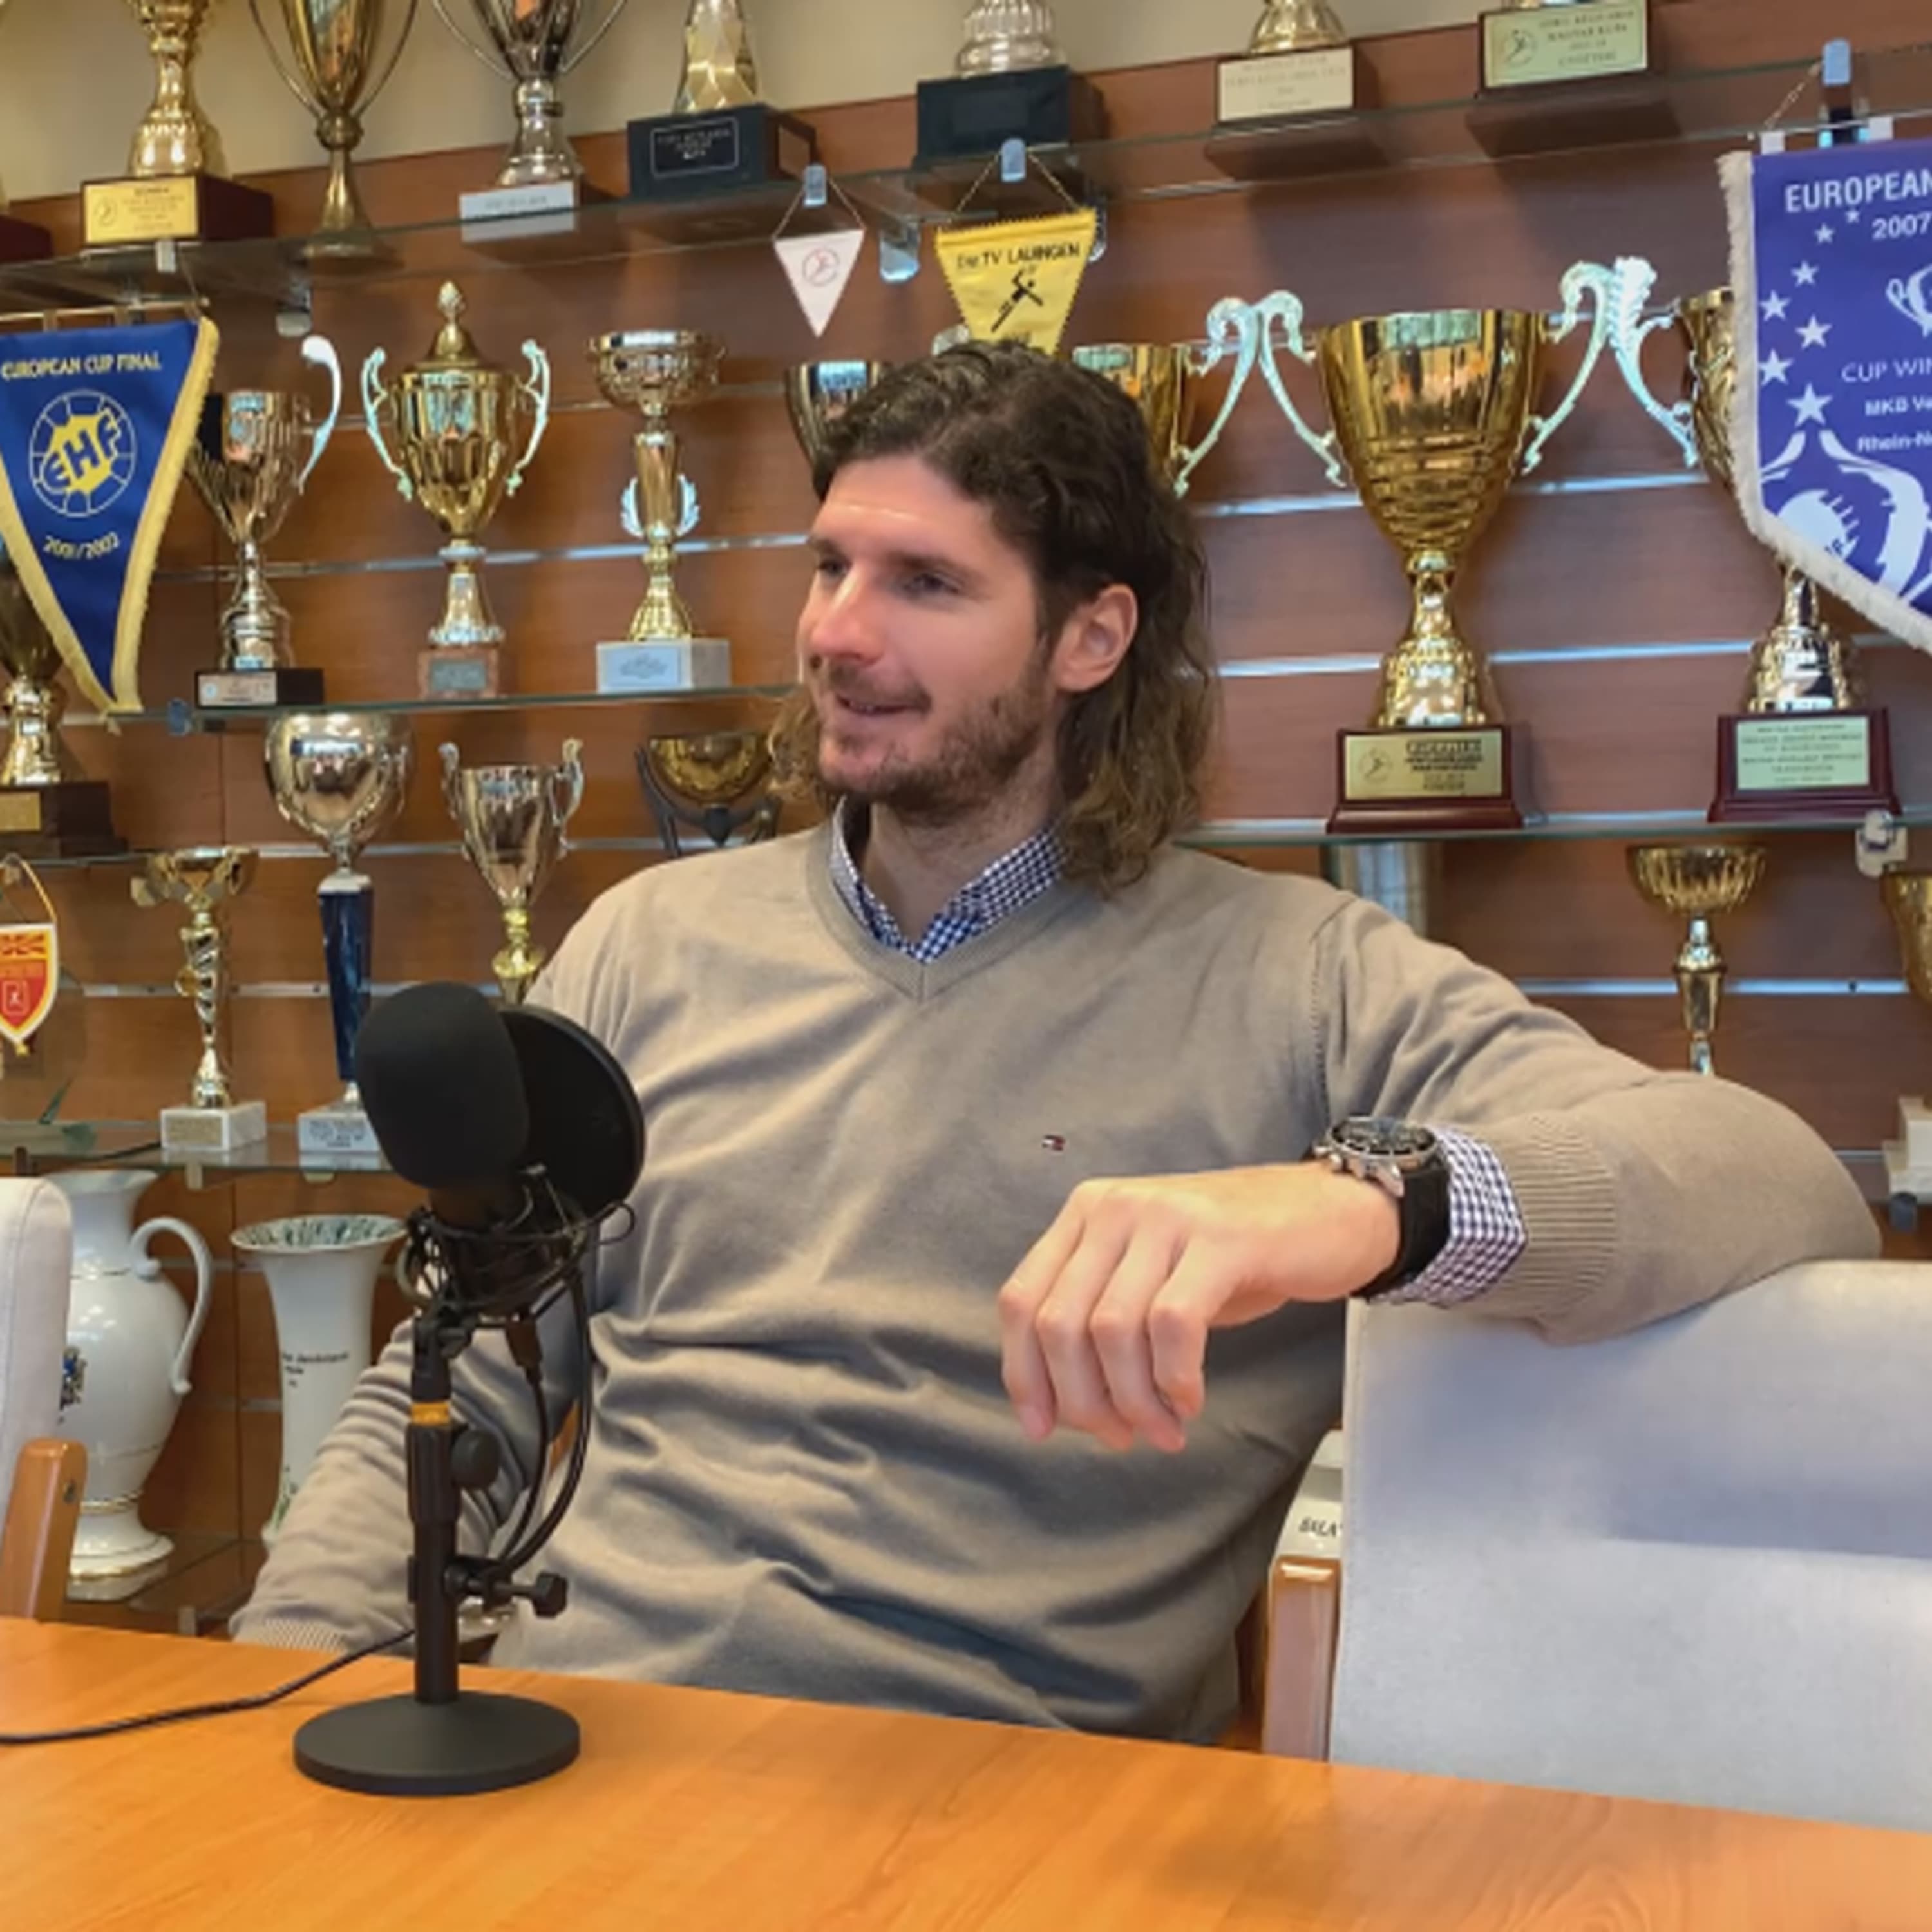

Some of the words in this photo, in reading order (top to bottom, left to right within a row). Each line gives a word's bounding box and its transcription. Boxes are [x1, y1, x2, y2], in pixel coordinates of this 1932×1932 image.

[1785, 169, 1932, 213] EUROPEAN
[1872, 212, 1932, 241] 2007
[1, 357, 82, 381] EUROPEAN
[84, 354, 114, 375] CUP
[116, 350, 162, 372] FINAL
[1841, 361, 1888, 383] CUP
[41, 407, 122, 493] EHF
